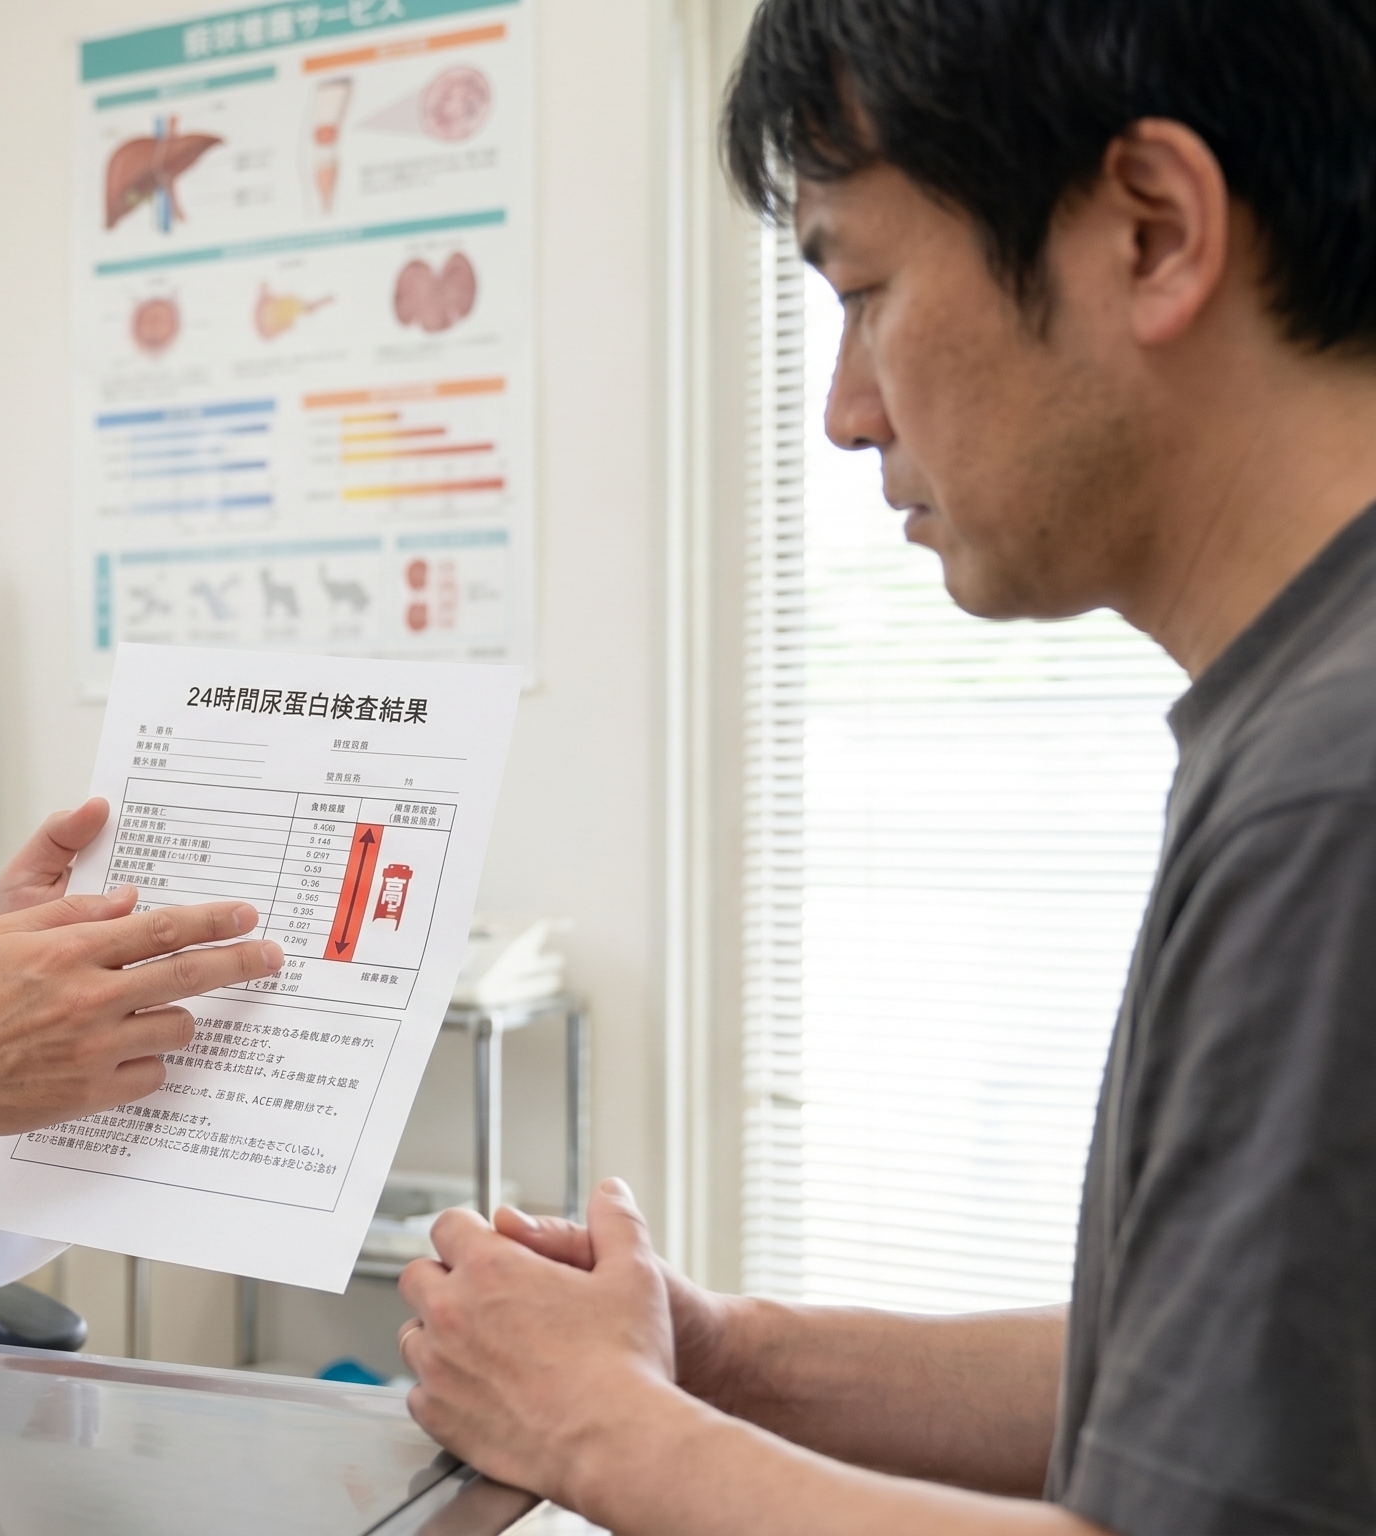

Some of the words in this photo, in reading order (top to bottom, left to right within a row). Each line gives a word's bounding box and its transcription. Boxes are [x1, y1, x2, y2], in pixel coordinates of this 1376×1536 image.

[186, 685, 429, 724] 24時間尿蛋白検査結果
